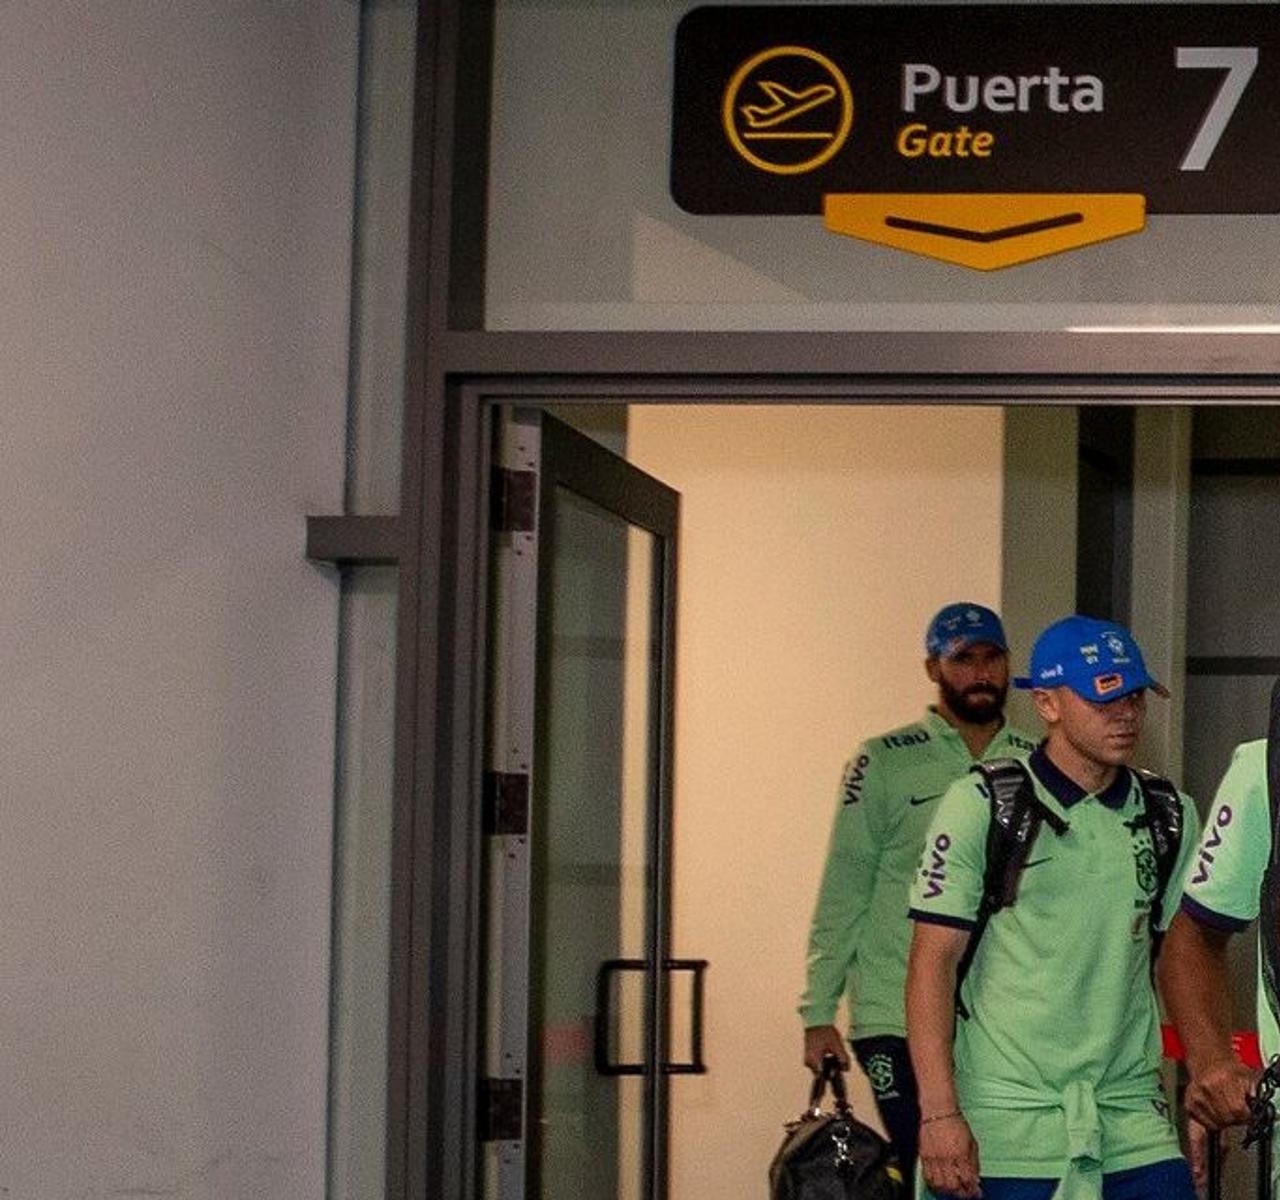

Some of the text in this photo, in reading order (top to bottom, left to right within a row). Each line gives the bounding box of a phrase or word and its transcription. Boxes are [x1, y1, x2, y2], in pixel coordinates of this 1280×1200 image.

[897, 123, 994, 158] Gate
[902, 46, 1259, 172] Puerta 7
[843, 754, 870, 806] vivo
[922, 833, 951, 899] vivo
[1191, 804, 1233, 884] vivo
